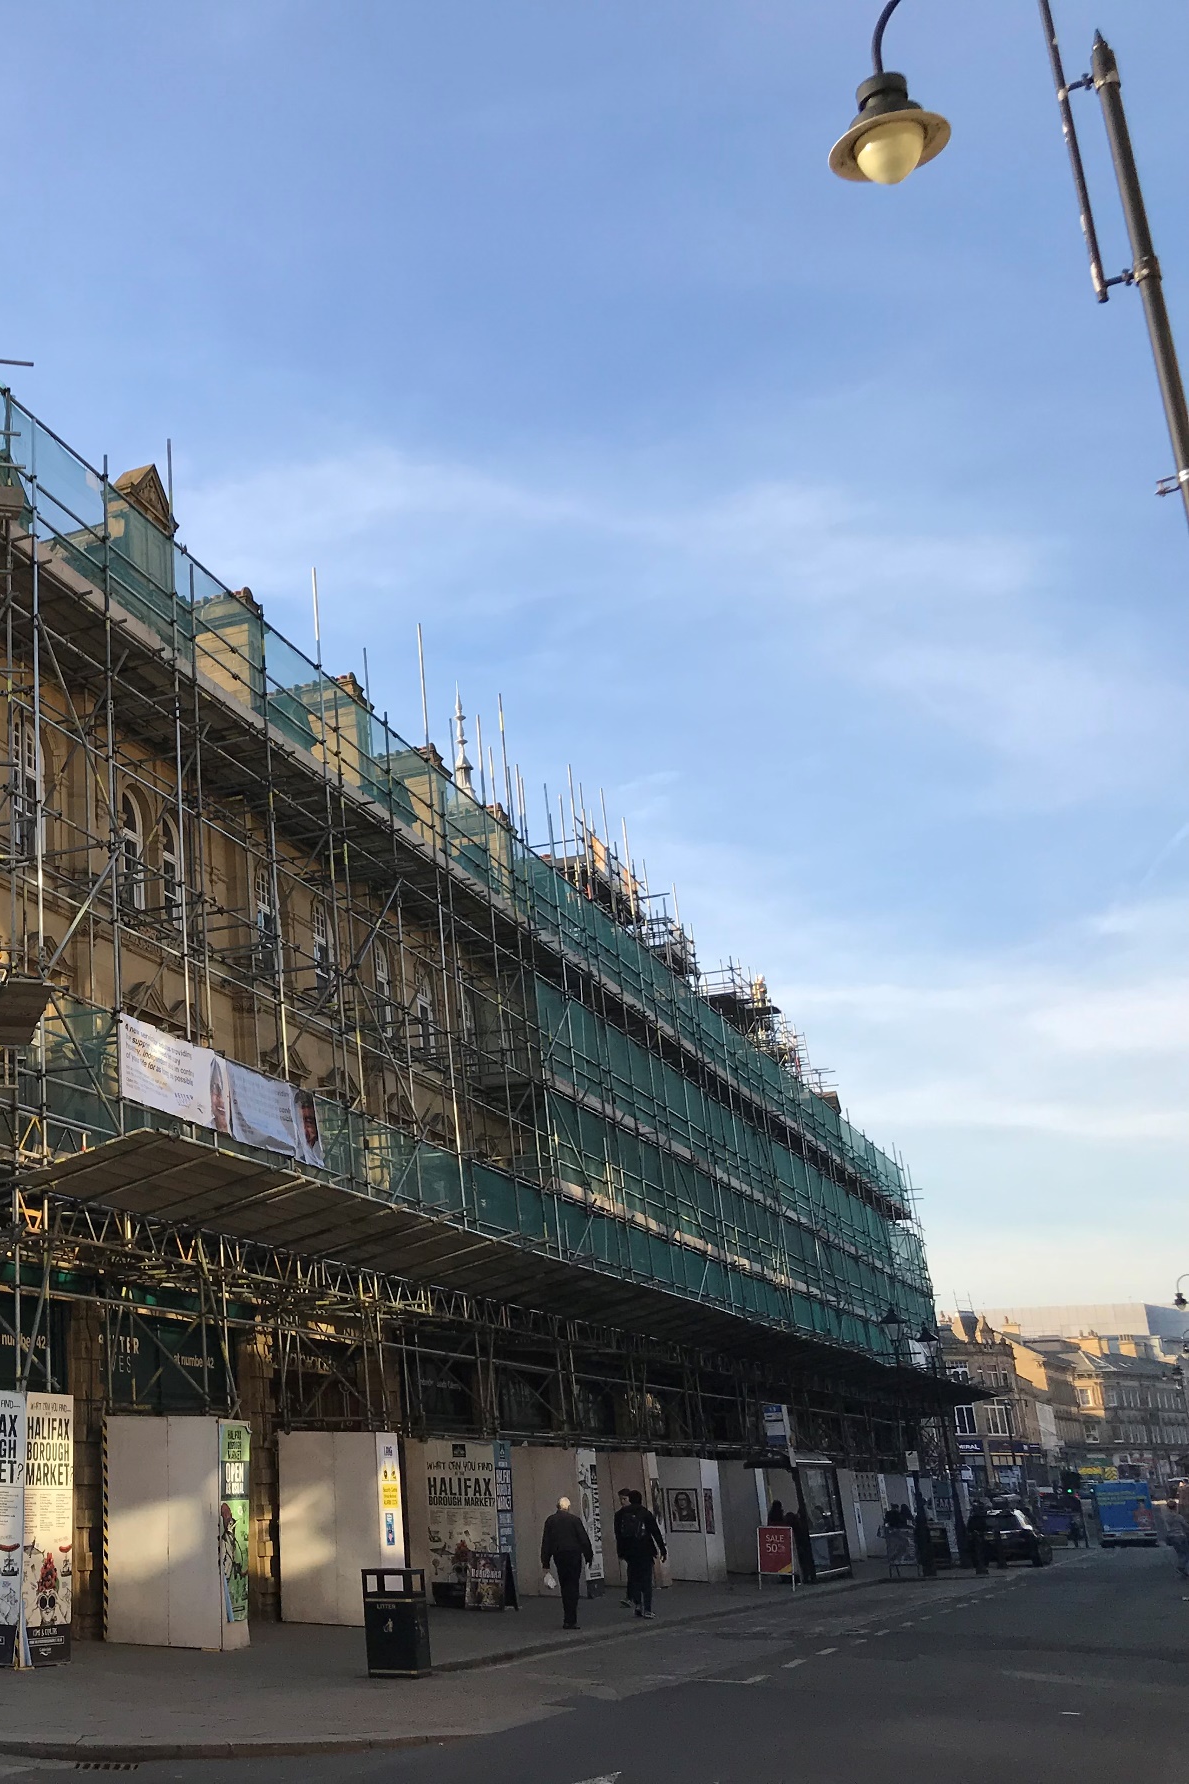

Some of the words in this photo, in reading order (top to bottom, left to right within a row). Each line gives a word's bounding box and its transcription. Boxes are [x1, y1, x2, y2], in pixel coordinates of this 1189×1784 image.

[35, 1335, 48, 1349] 42
[181, 1355, 205, 1368] numbe
[27, 1416, 70, 1441] HALIFAX
[26, 1441, 70, 1461] BOROUGH
[226, 1462, 244, 1482] OPEN
[427, 1461, 446, 1470] WHAT
[448, 1461, 461, 1470] CAN
[463, 1461, 476, 1472] YOU
[477, 1462, 493, 1472] FIND
[427, 1477, 493, 1496] HALIFAX
[428, 1495, 462, 1506] BOROUGH
[464, 1496, 496, 1507] MARKET?
[765, 1534, 785, 1542] SALE
